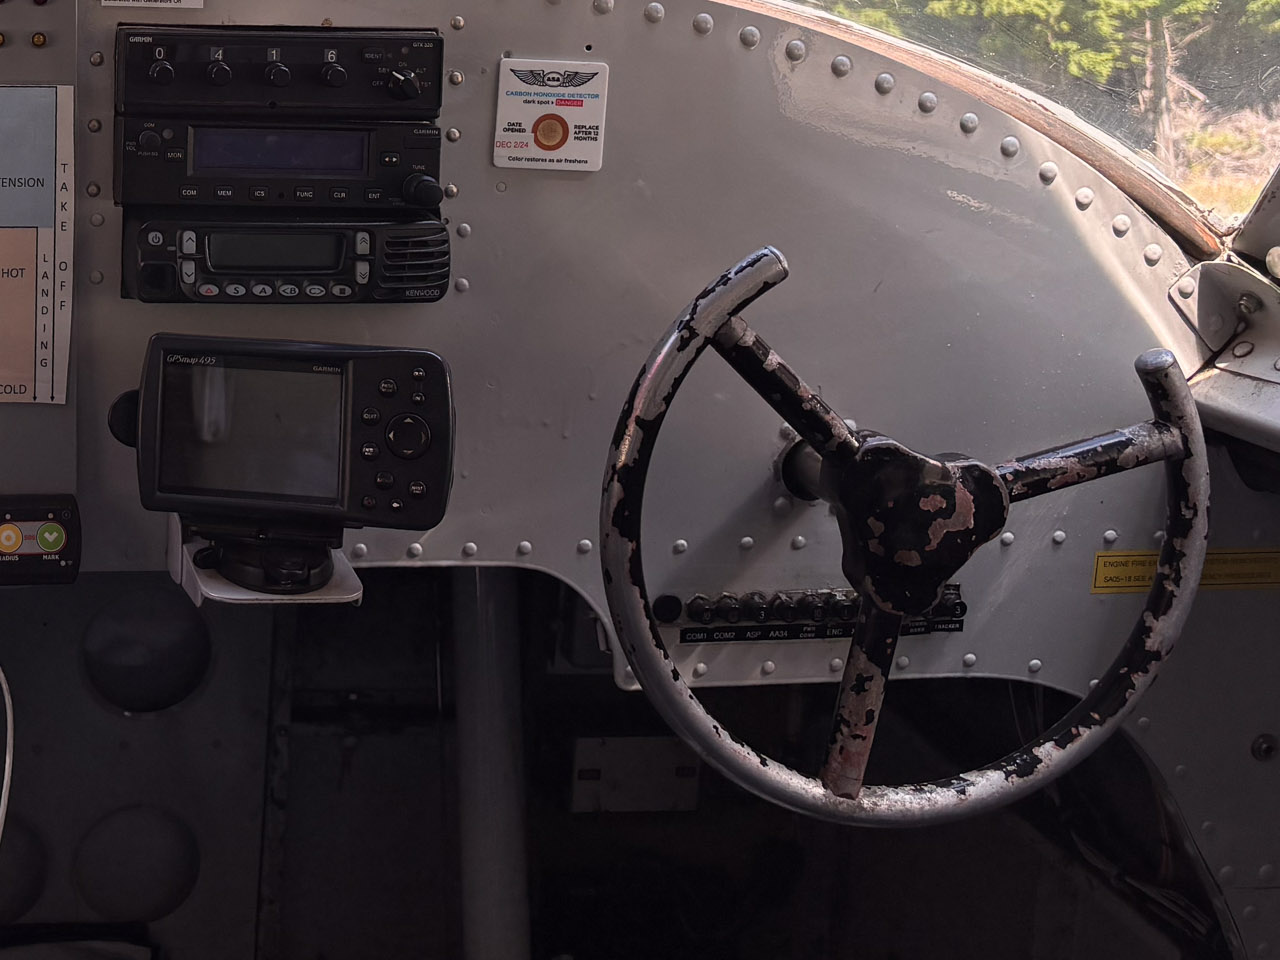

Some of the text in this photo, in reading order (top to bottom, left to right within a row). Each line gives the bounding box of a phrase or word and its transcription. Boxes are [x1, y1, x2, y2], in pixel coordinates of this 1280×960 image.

[1, 268, 26, 278] HOT
[405, 289, 440, 297] KENWOOD
[167, 354, 216, 365] GPSmap 495
